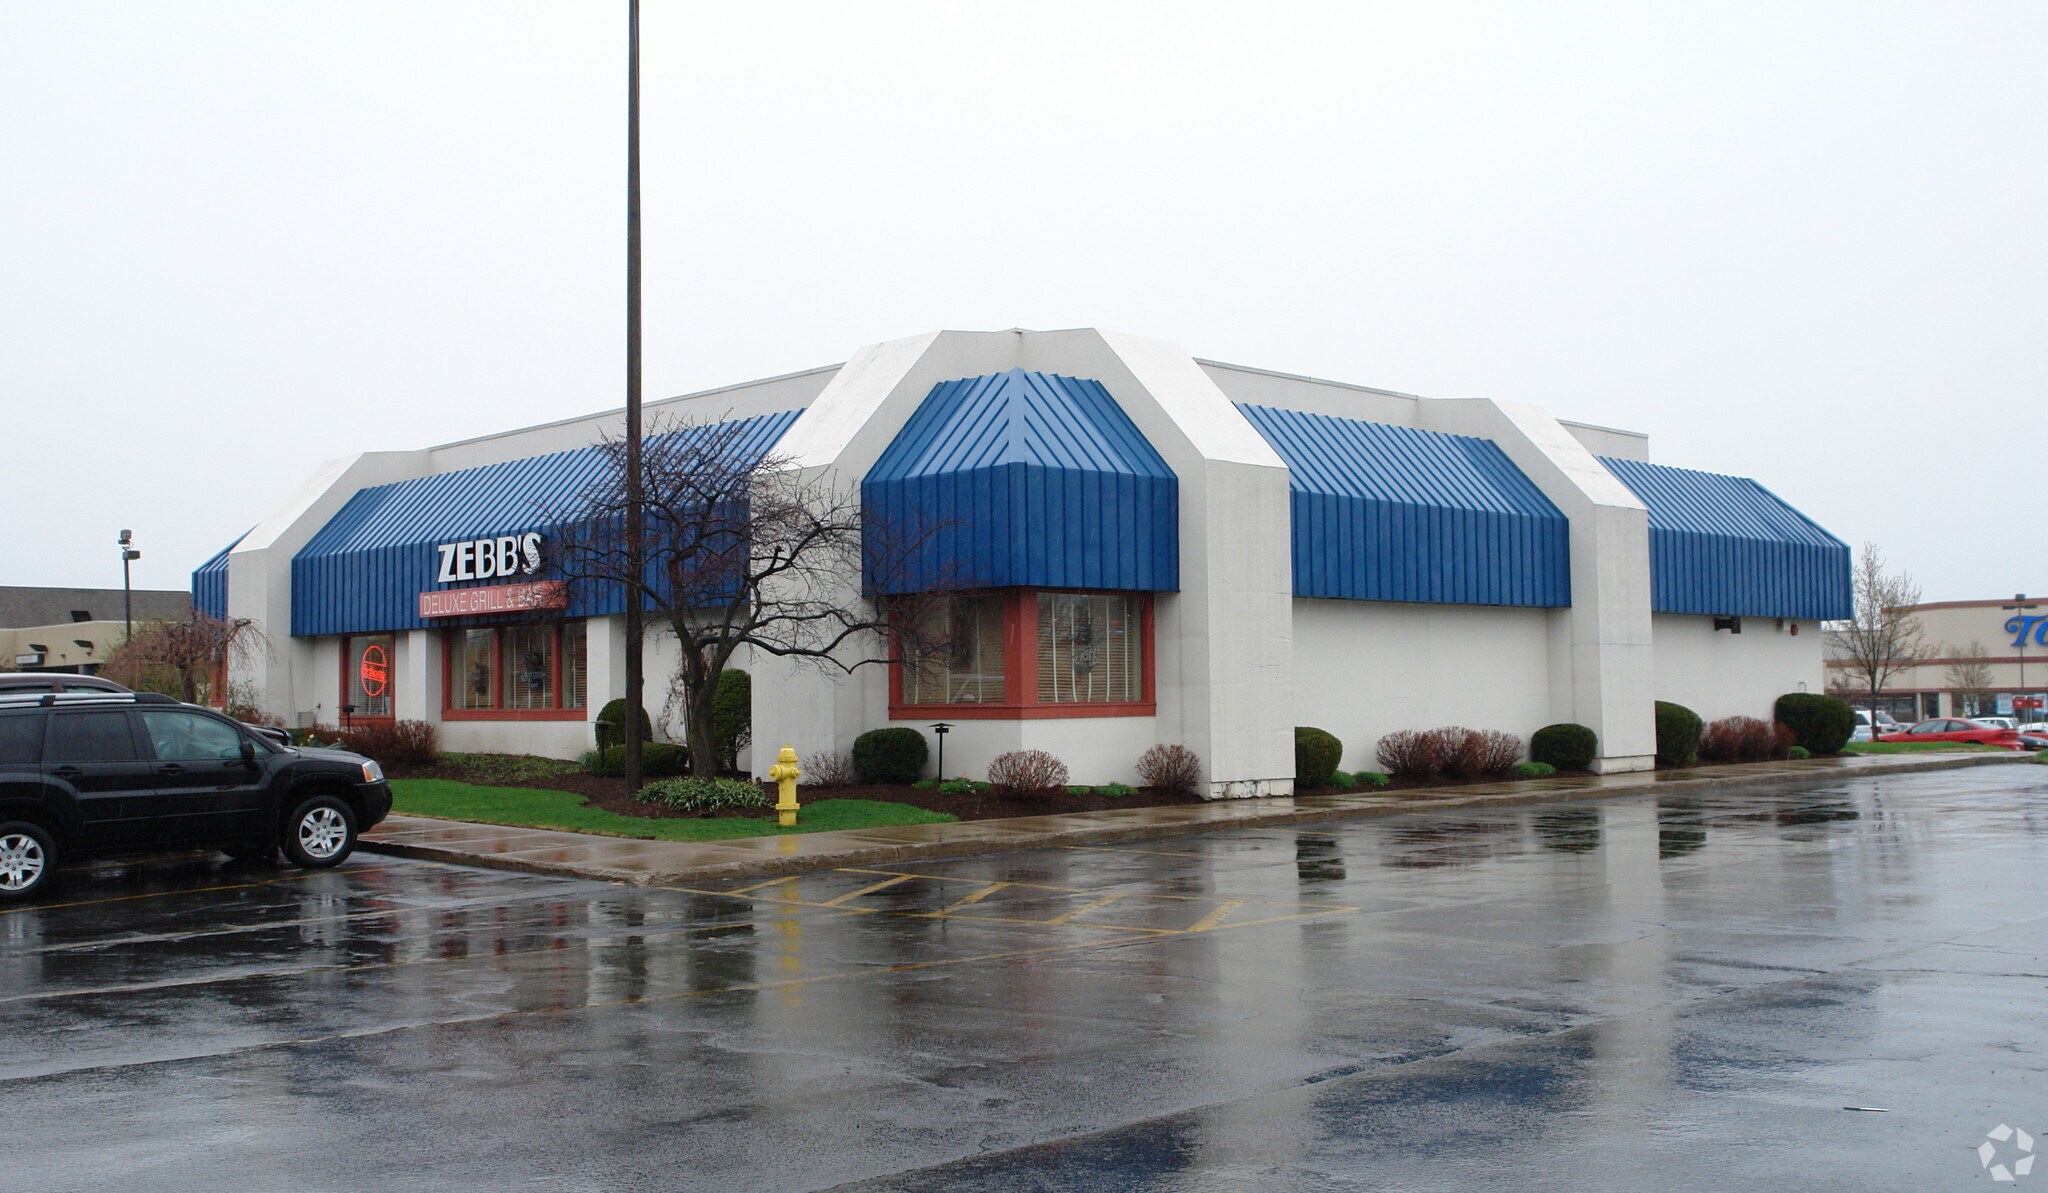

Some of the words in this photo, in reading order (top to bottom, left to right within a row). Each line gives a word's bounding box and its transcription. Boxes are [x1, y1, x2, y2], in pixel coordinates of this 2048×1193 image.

[438, 532, 542, 583] ZEBB'S
[423, 592, 467, 615] DELUXE
[470, 589, 503, 612] GRILL
[506, 588, 514, 608] &
